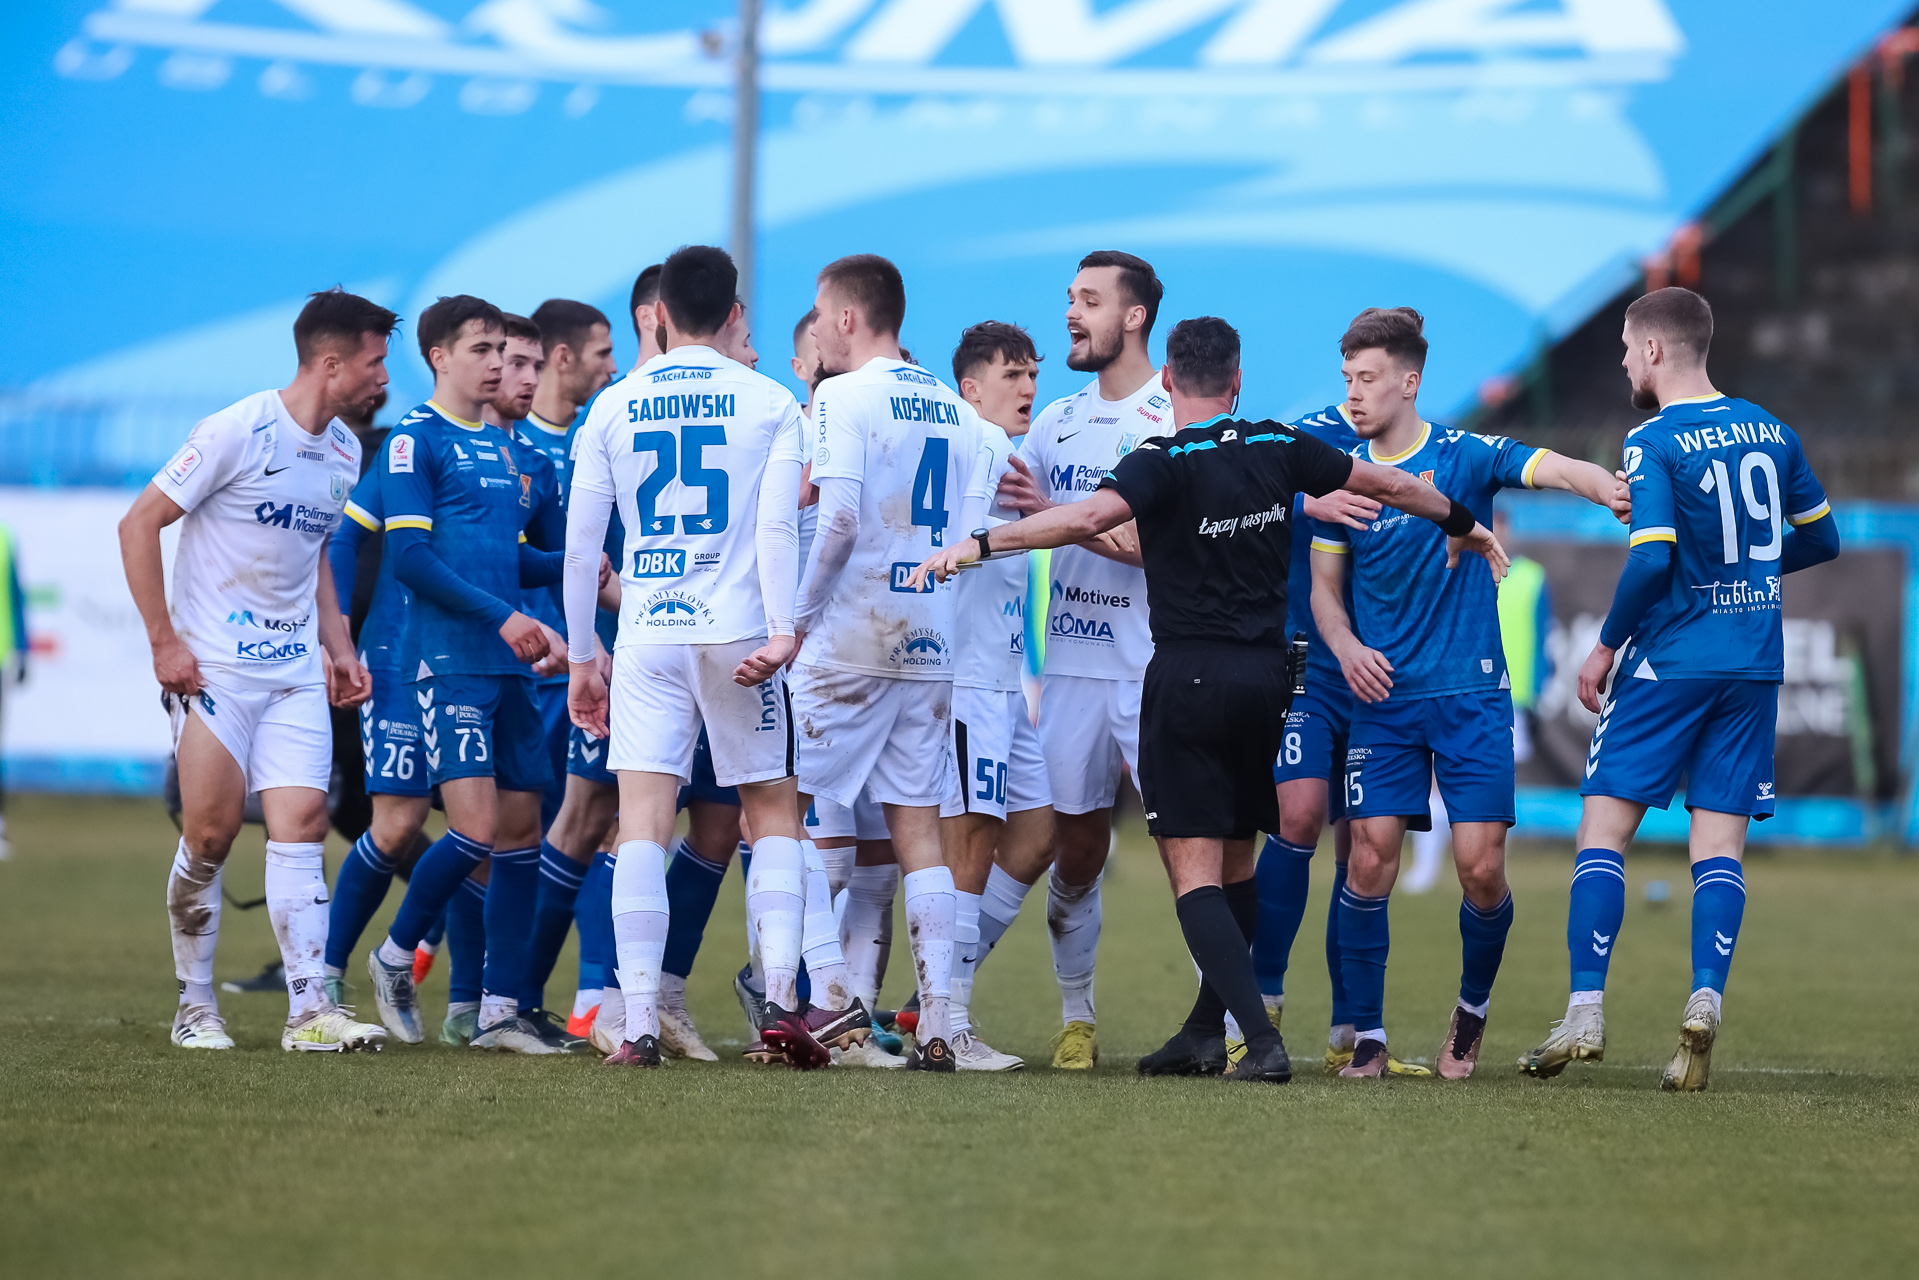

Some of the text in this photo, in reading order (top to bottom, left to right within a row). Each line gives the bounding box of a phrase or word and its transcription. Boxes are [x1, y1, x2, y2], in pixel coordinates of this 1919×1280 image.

[652, 370, 712, 384] DACHLAND
[895, 373, 938, 387] DACHLAND
[628, 393, 735, 424] SADOWSKI
[819, 401, 827, 444] SOLIN
[889, 392, 961, 426] KOŚMICKI
[1674, 421, 1787, 454] WEŁNIAK
[632, 424, 730, 537] 25
[910, 436, 949, 548] 4
[1698, 451, 1783, 565] 19
[1198, 517, 1239, 539] Łączy
[637, 552, 721, 575] DBK GROUP
[634, 589, 716, 626] PRZEMYSŁÓWKA
[1065, 586, 1131, 608] Motives
[1712, 603, 1781, 615] MIASTO INSPIR
[646, 618, 697, 627] HOLDING
[902, 657, 942, 666] HOLDING
[380, 742, 416, 780] 26
[454, 727, 488, 762] 73
[976, 757, 1008, 806] 50
